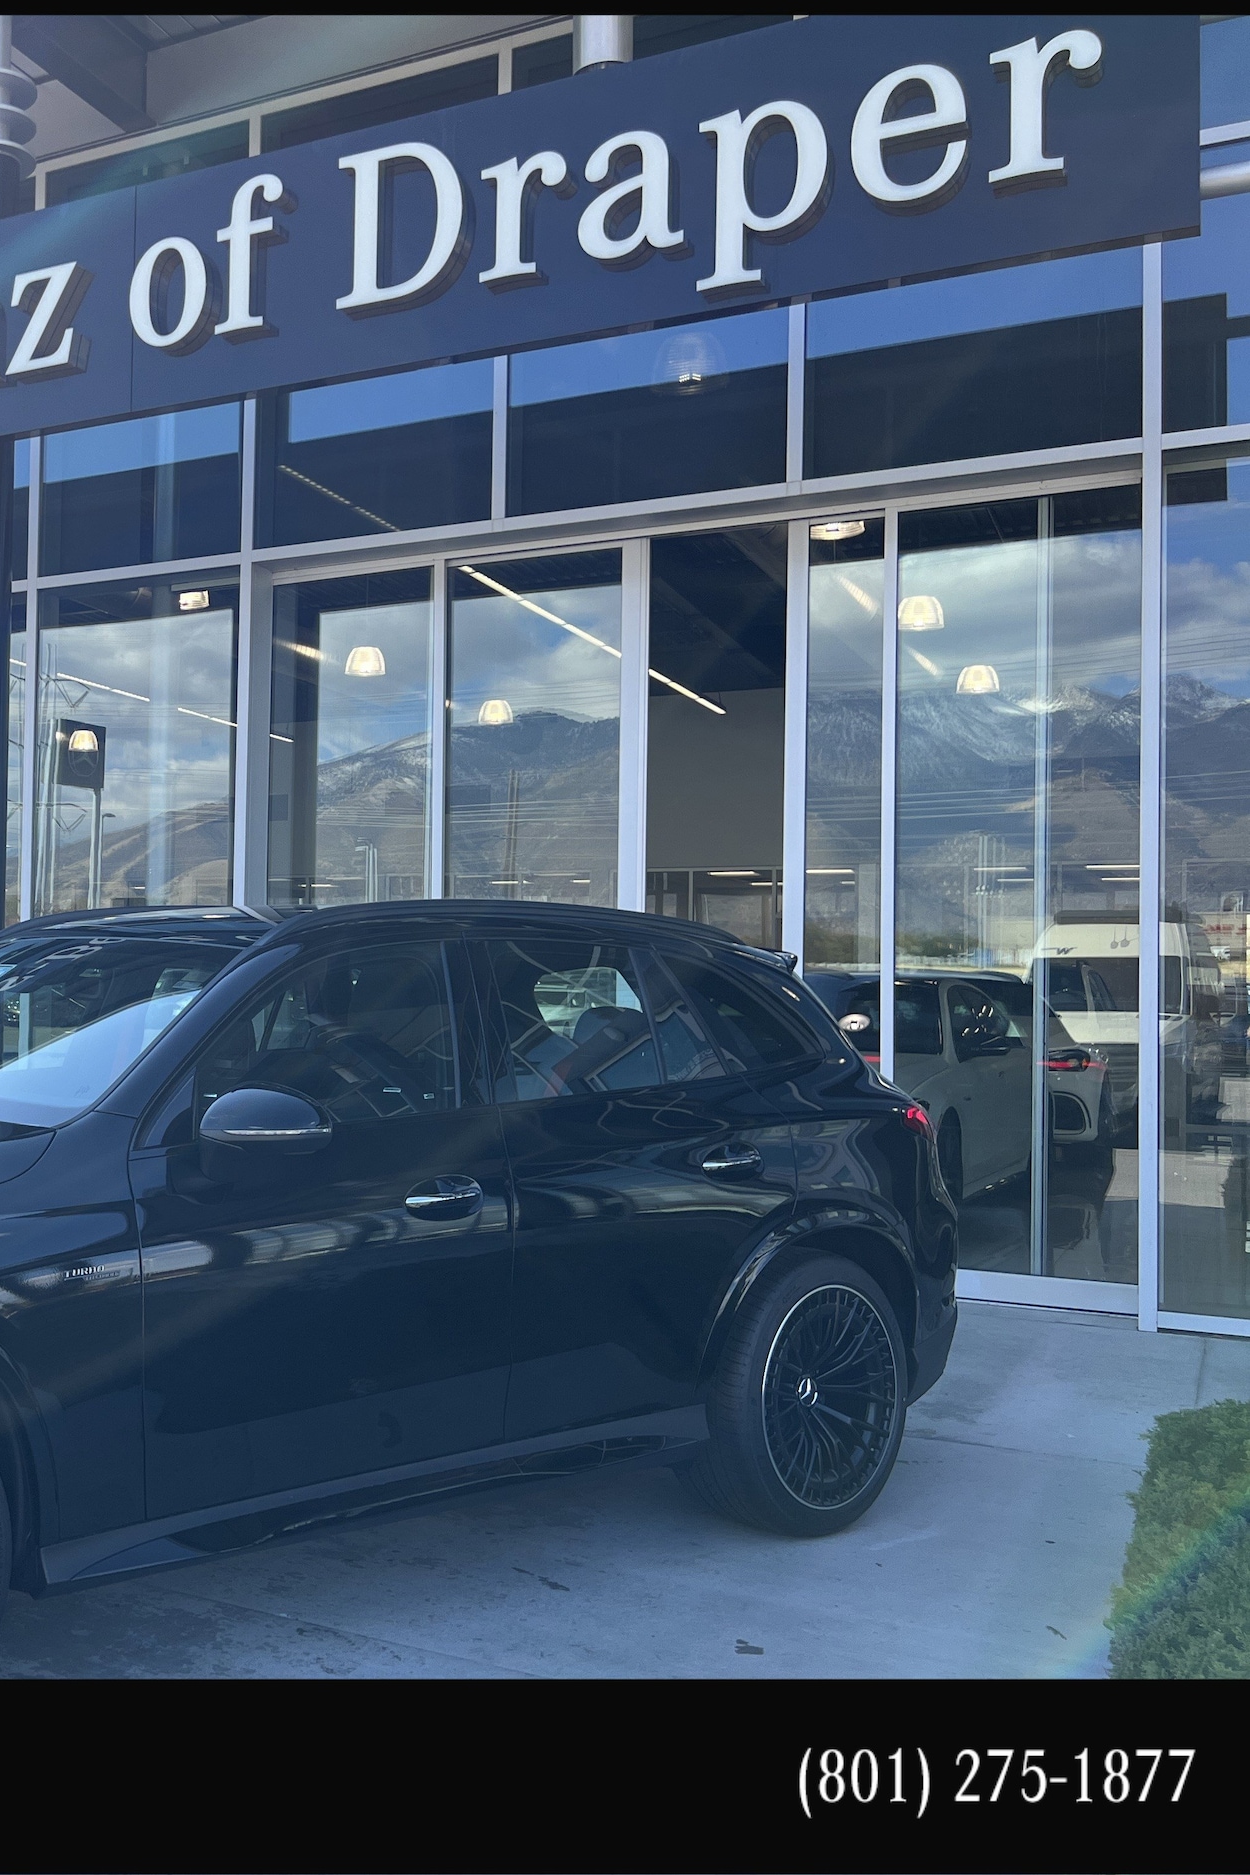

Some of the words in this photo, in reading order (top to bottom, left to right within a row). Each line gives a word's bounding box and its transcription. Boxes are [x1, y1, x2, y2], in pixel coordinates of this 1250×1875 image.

[129, 173, 284, 348] of
[336, 29, 1103, 311] Draper
[64, 1264, 105, 1278] TURBO
